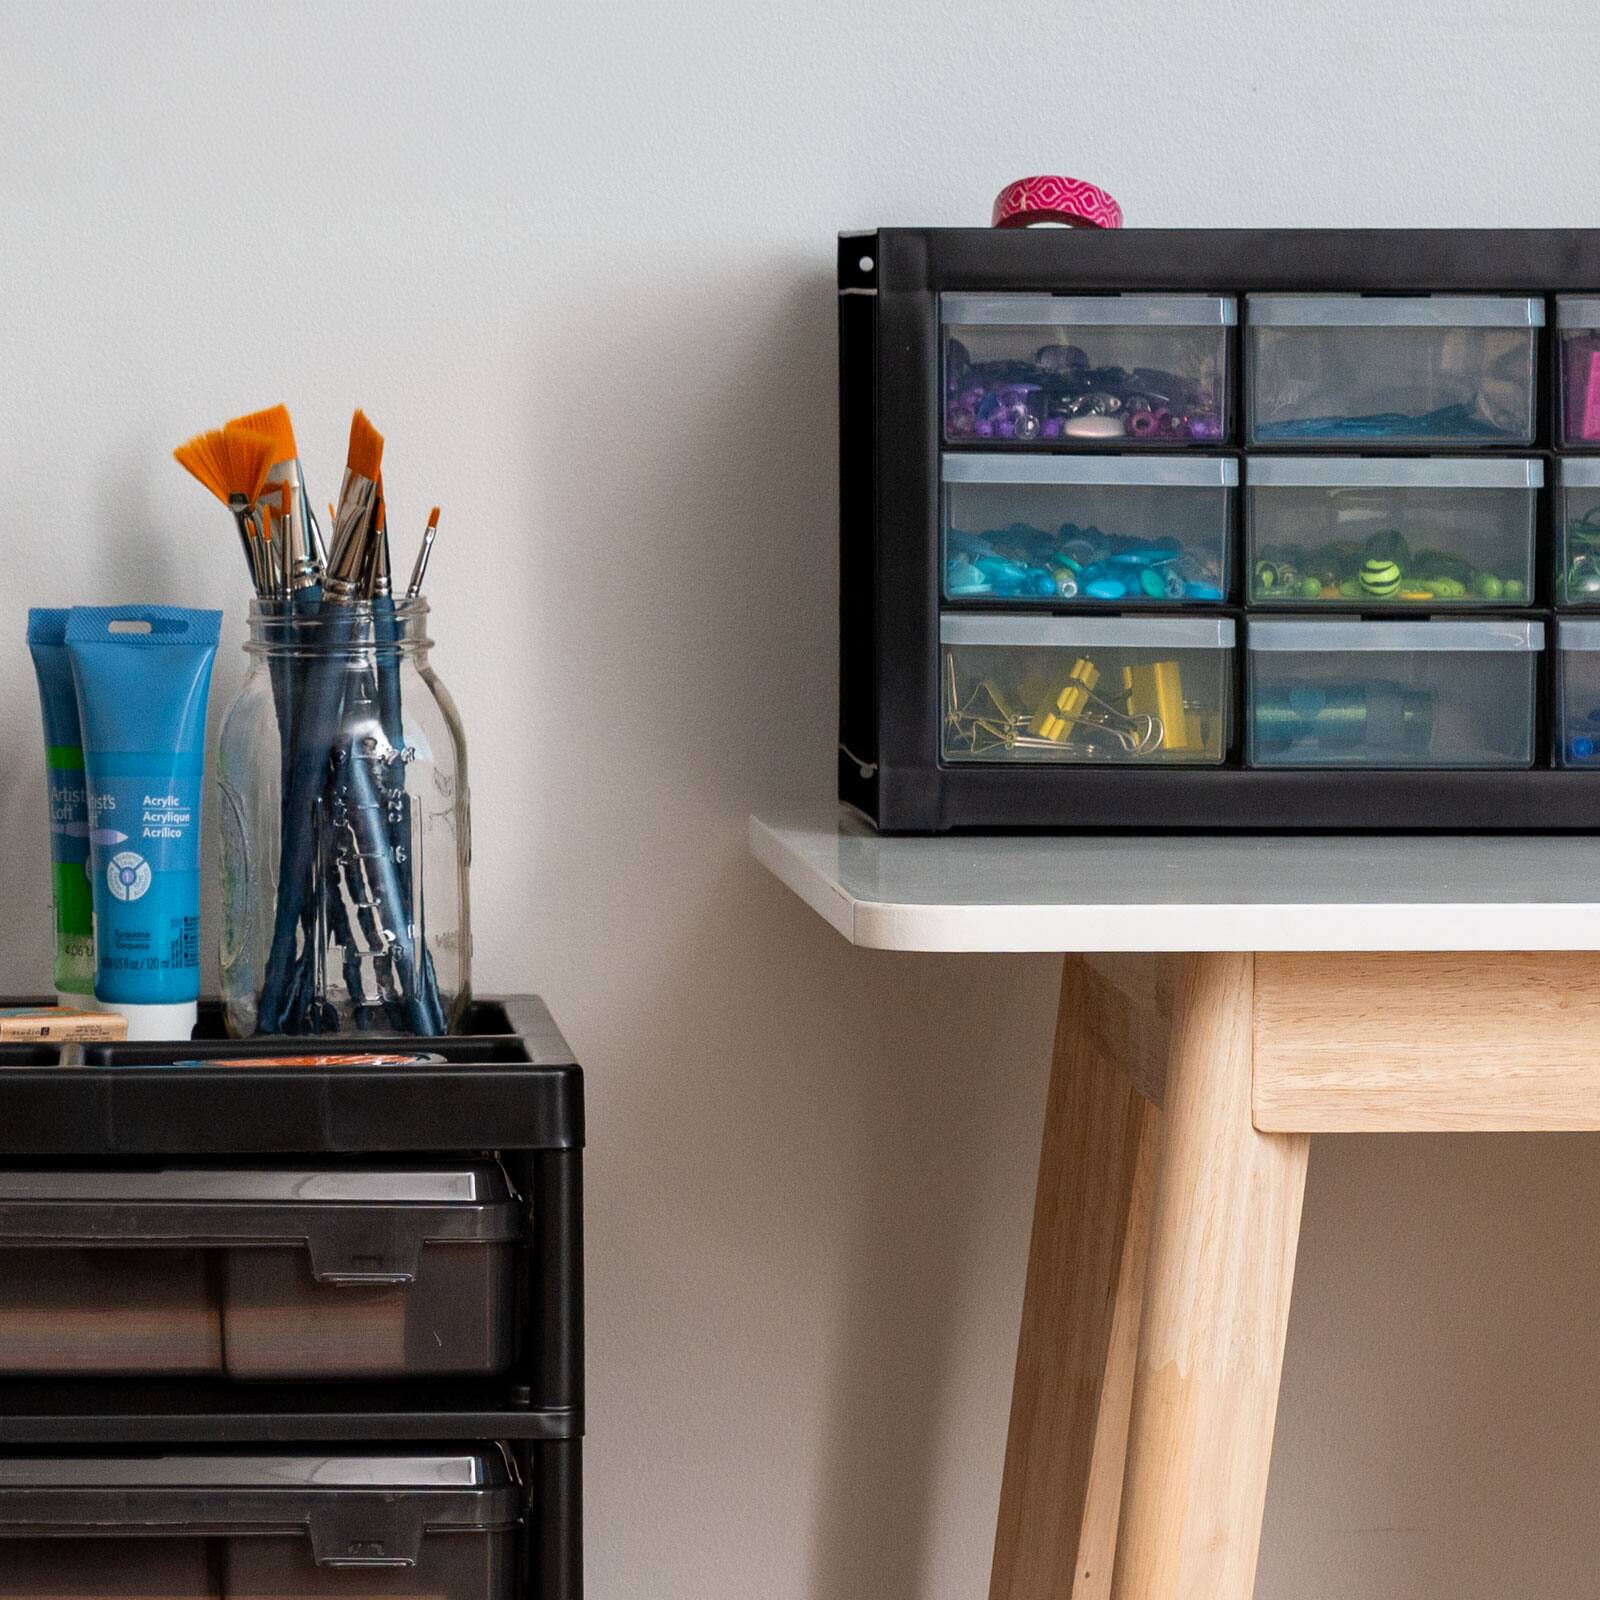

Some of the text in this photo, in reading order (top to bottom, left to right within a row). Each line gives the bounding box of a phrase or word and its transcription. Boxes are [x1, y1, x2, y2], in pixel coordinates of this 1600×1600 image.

[51, 786, 86, 802] Artist
[142, 795, 180, 808] Acrylic
[142, 811, 190, 824] Acrylique
